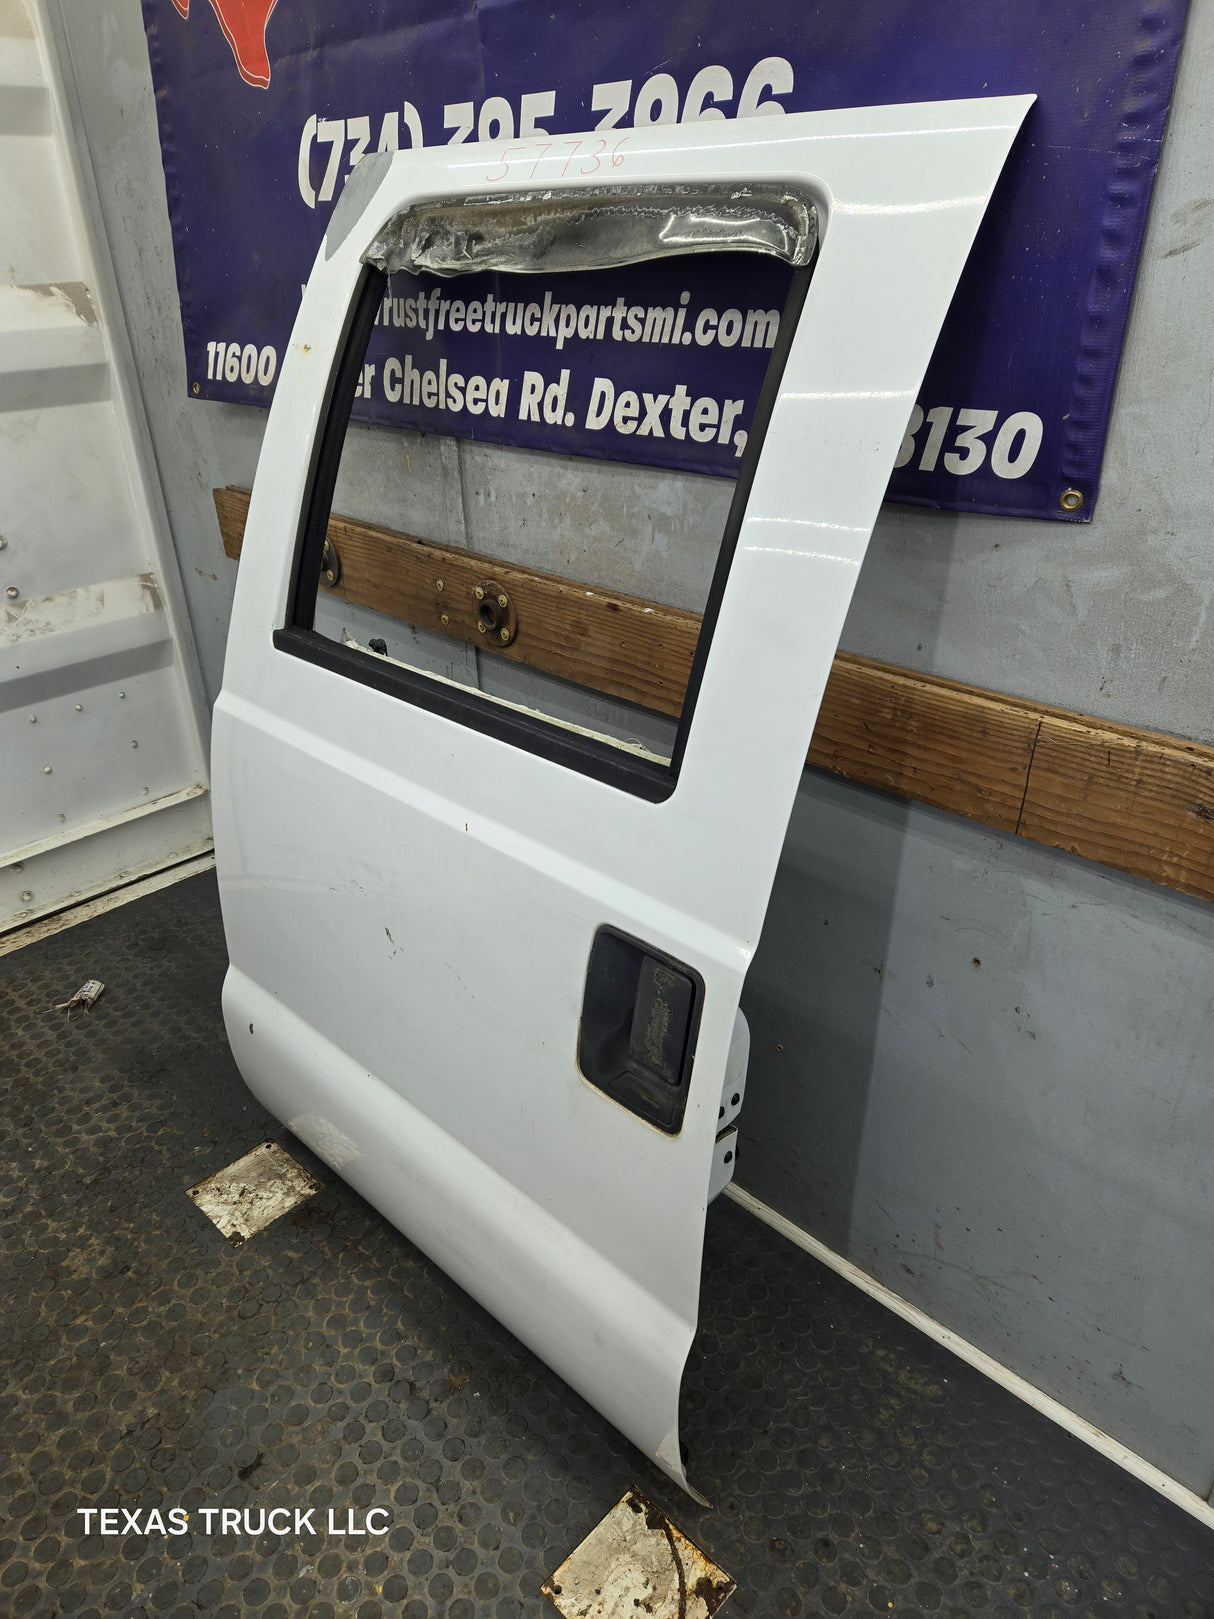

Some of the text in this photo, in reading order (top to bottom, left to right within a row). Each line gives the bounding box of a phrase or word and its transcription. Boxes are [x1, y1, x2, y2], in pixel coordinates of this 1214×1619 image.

[486, 136, 630, 182] 57736
[206, 341, 277, 386] 11600
[383, 355, 510, 418] Chelsea
[518, 369, 575, 427] Rd.
[585, 377, 748, 458] Dexter,
